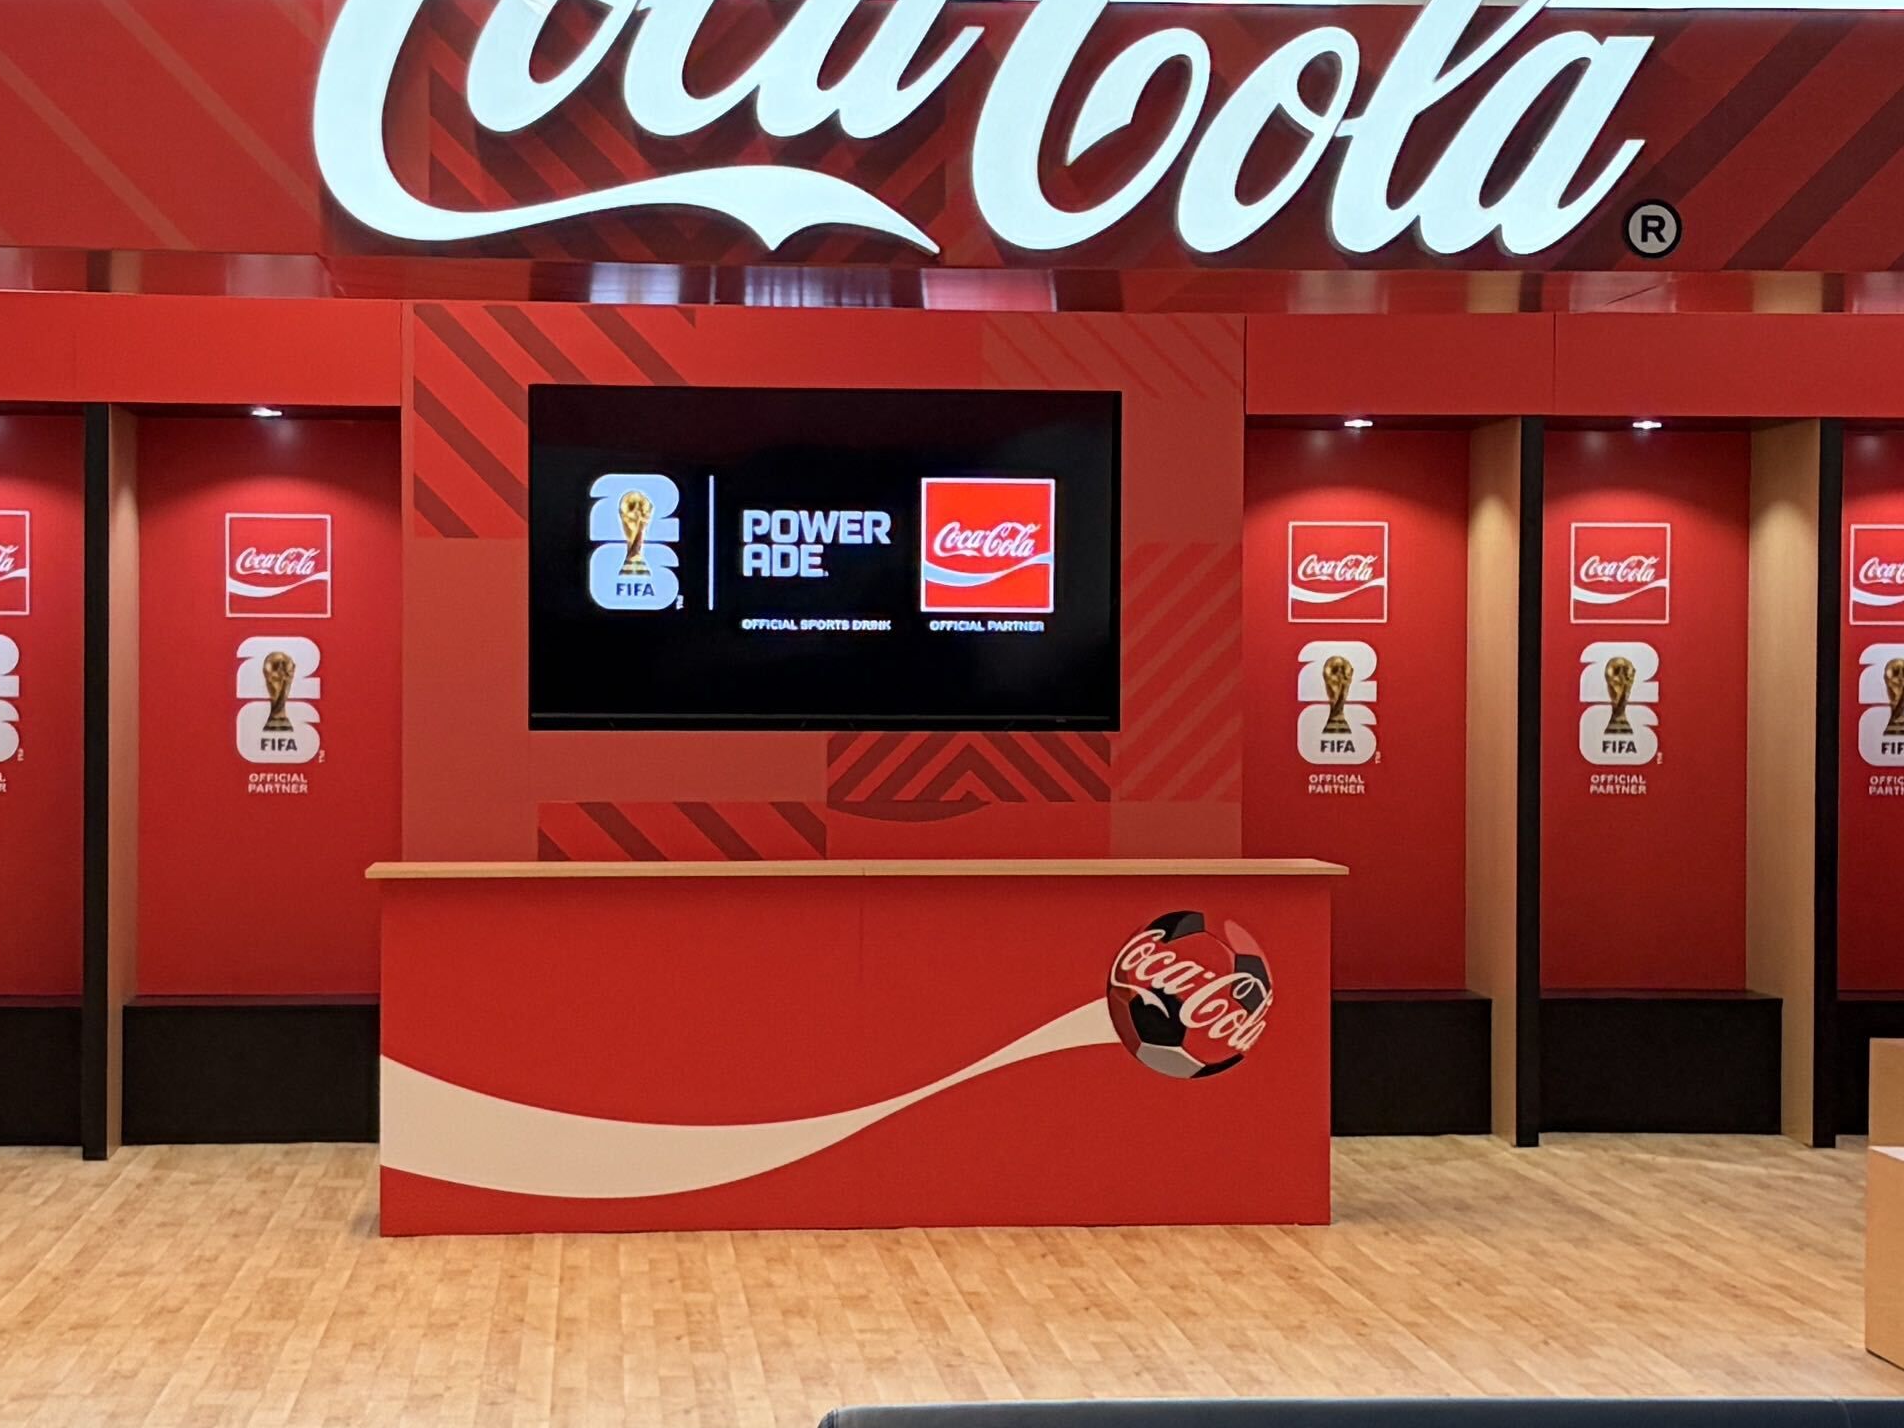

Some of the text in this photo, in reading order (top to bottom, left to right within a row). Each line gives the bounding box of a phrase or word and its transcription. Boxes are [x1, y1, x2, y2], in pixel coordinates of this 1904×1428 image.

[742, 509, 892, 544] POWER
[933, 521, 1041, 558] Coca-Cola
[235, 547, 321, 576] Coca-Cola
[1297, 554, 1377, 582] Coca-Cola
[1579, 555, 1660, 583] Coca-Cola
[616, 582, 655, 597] FIFA
[741, 618, 892, 632] OFFICIAL SPORTS DRINK
[929, 620, 1045, 633] OFFICIAL PARTNER
[260, 738, 298, 752] FIFA
[1320, 739, 1356, 753] FIFA
[1601, 740, 1637, 754] FIFA
[249, 773, 308, 783] OFFICIAL
[1309, 774, 1364, 784] OFFICIAL
[1590, 774, 1646, 784] OFFICIAL
[248, 783, 308, 794] PARTNER
[1308, 784, 1366, 795] PARTNER
[1589, 784, 1647, 795] PARTNER
[1111, 929, 1273, 1052] Coca-Cola
